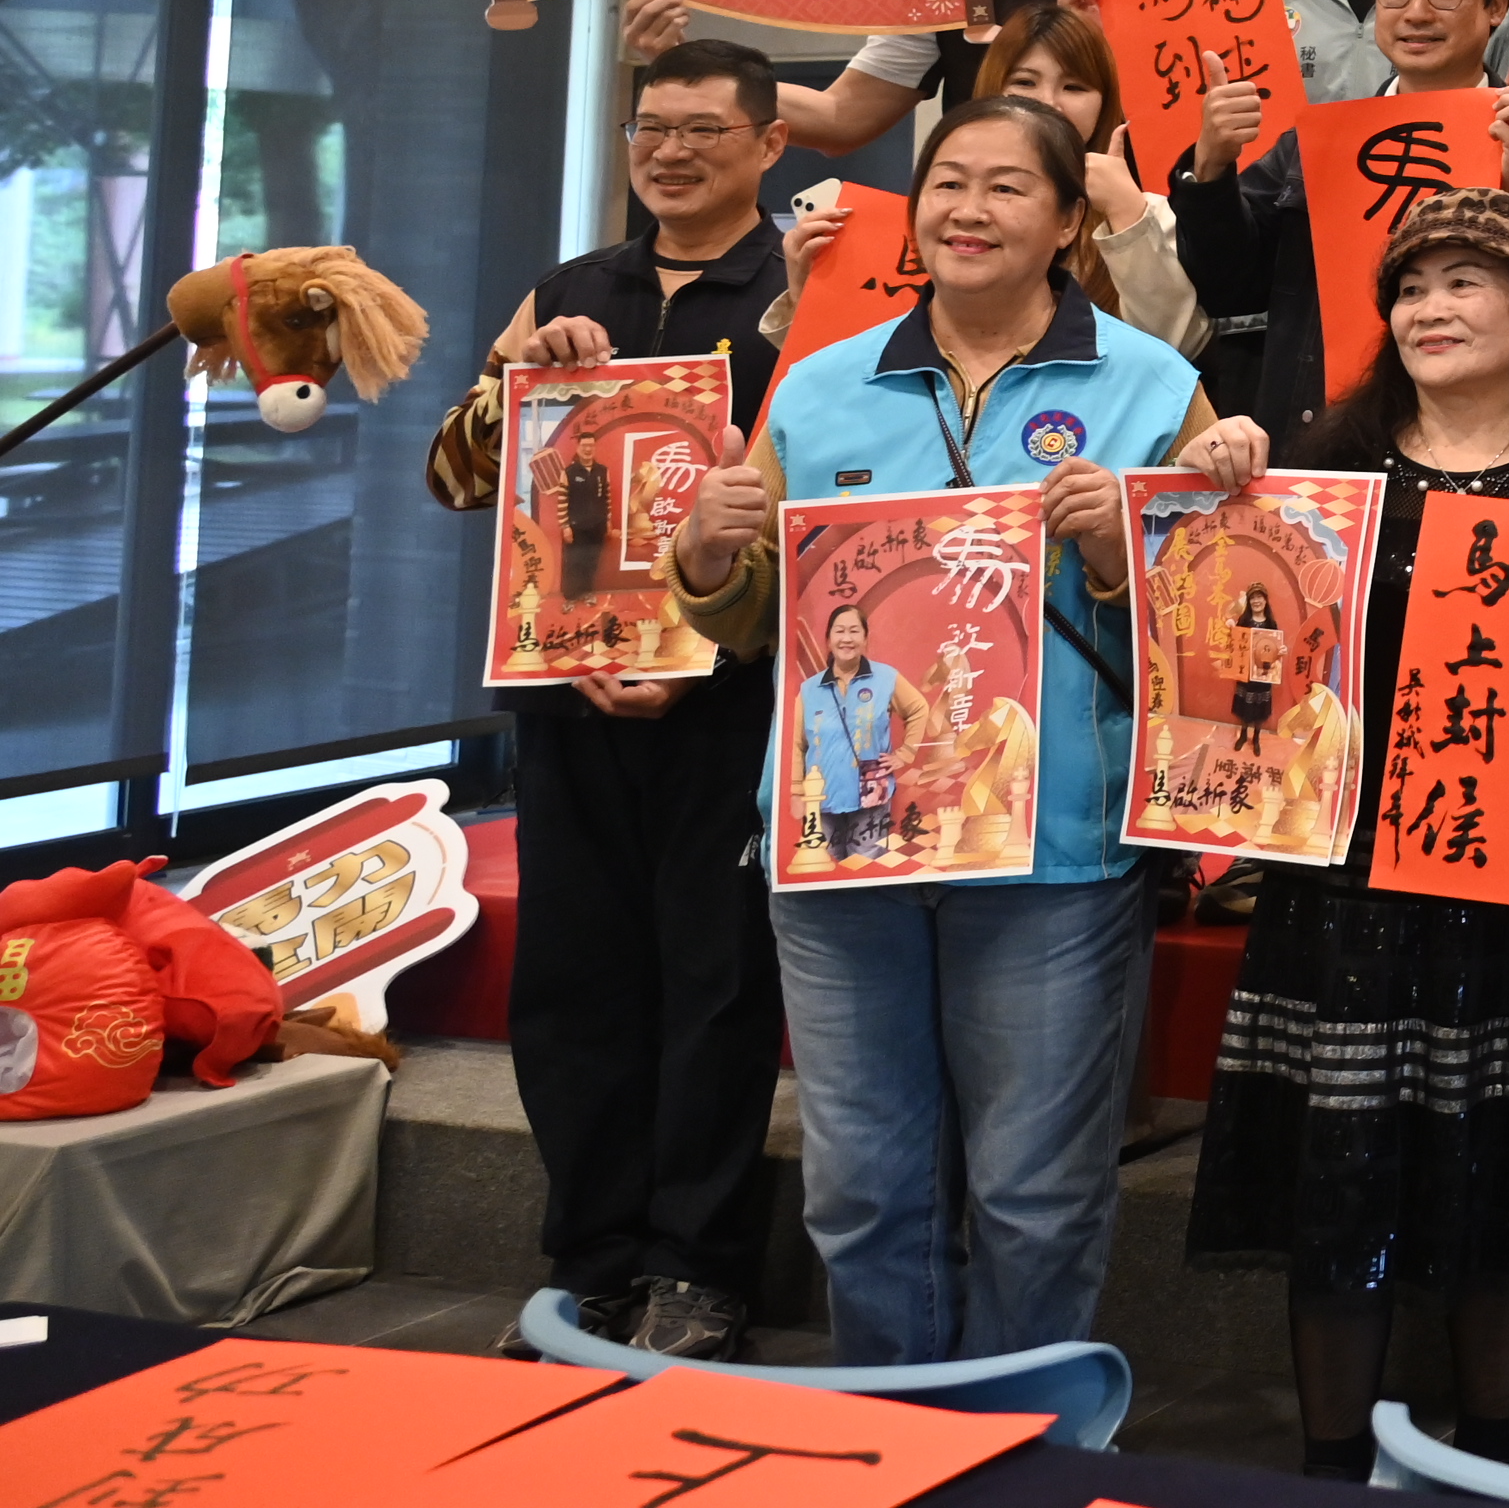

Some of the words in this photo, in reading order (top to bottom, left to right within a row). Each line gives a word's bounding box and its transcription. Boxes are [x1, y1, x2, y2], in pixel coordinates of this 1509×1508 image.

[828, 518, 932, 600] 馬啟新象
[1144, 769, 1255, 817] 馬啟新象
[794, 802, 930, 850] 馬啟新象
